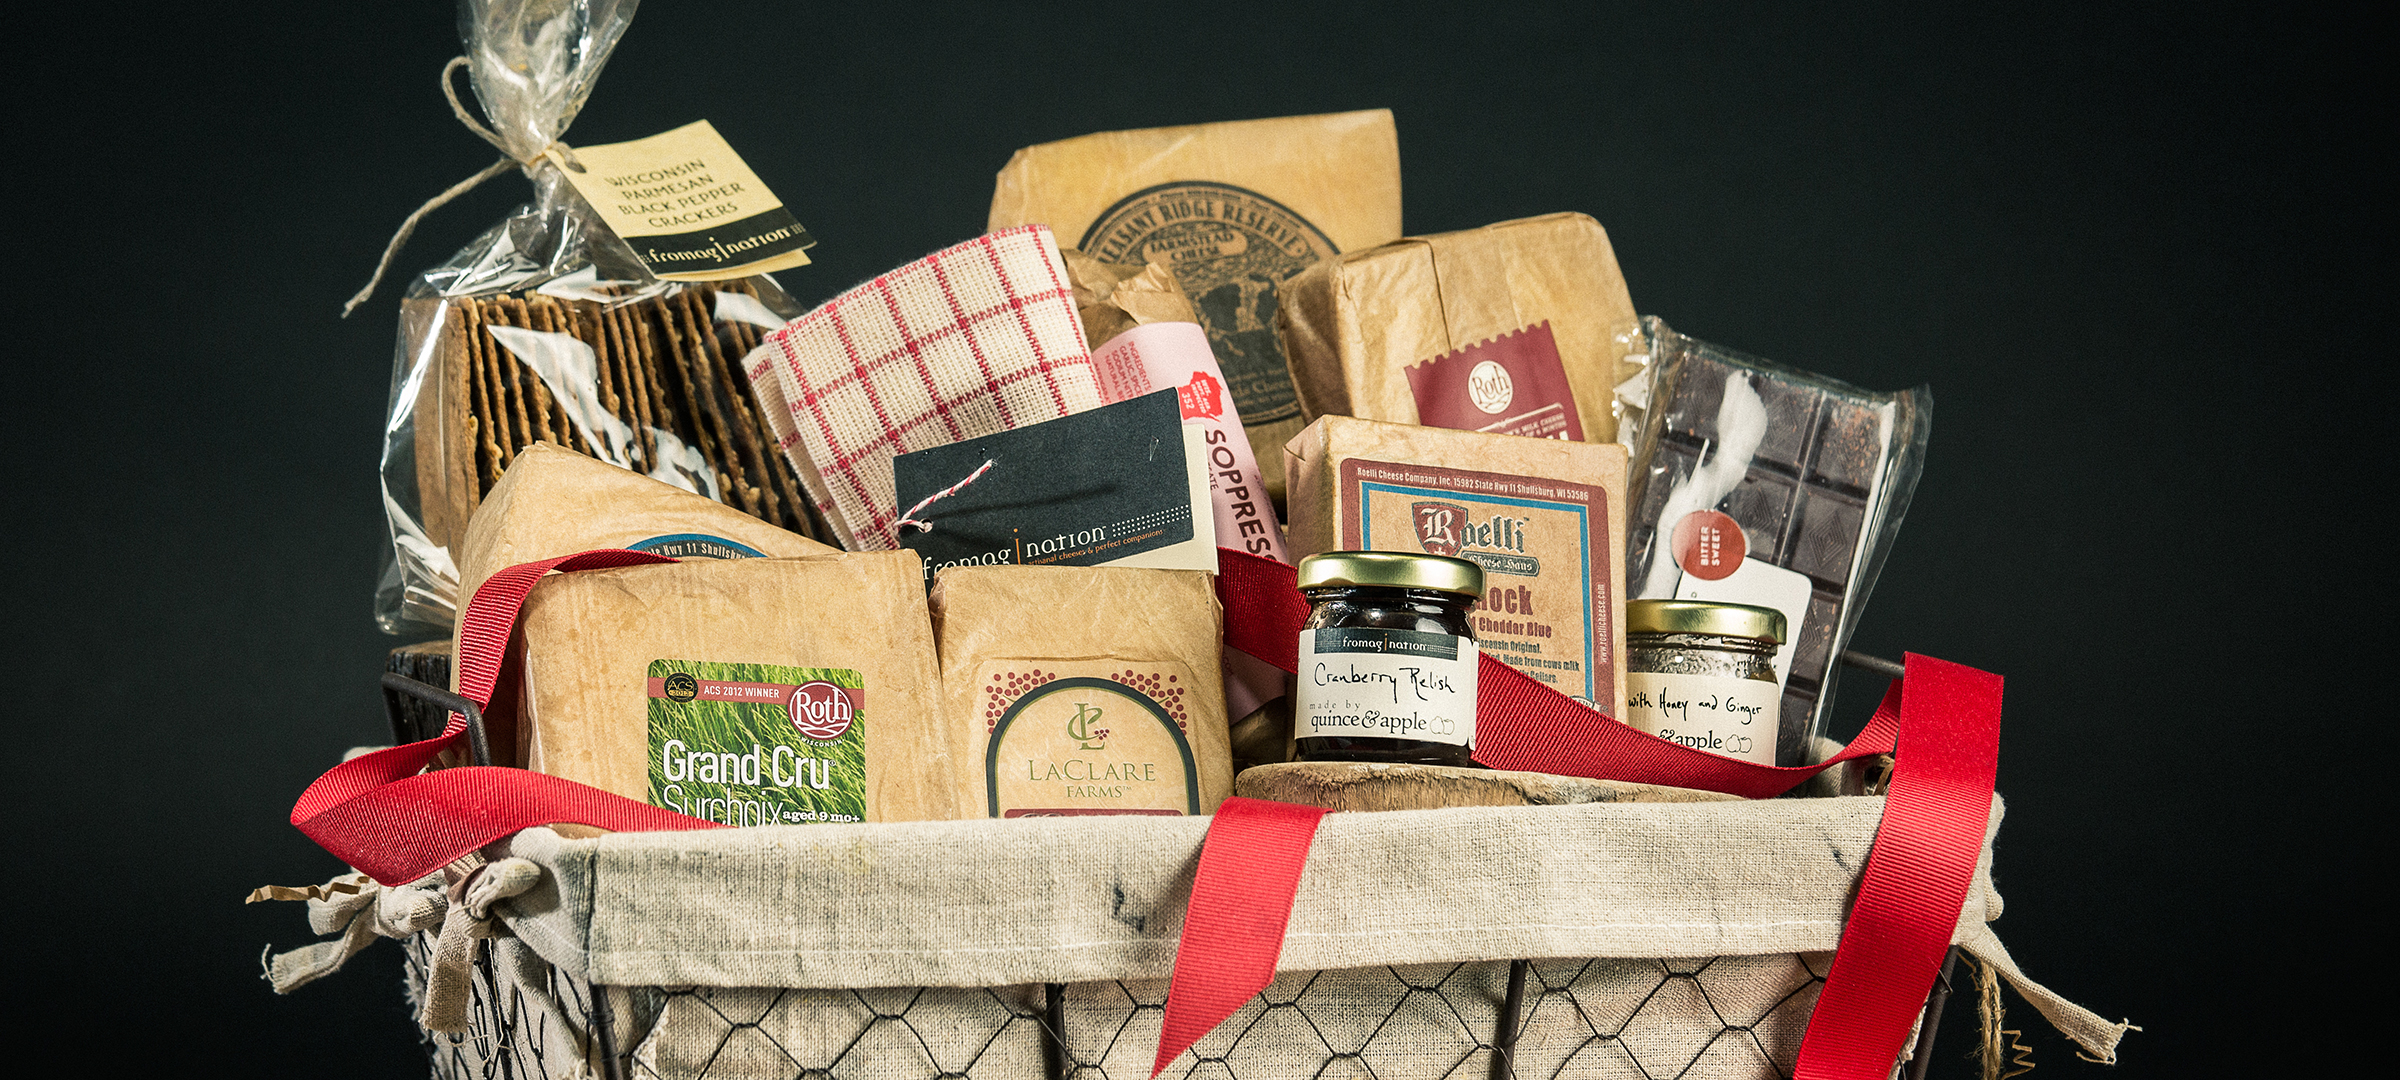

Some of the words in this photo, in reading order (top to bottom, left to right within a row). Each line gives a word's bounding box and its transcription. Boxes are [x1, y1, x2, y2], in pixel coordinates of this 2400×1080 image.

[604, 159, 706, 187] WISCONSIN
[621, 174, 714, 200] PARMESAN
[618, 201, 676, 215] BLACK
[677, 182, 745, 208] PEPPER
[649, 201, 738, 228] CRACKERS
[1159, 201, 1215, 222] RIDGE
[1223, 203, 1298, 249] RESERVE
[1151, 233, 1234, 253] FARMSTEAD
[1472, 365, 1510, 405] Roth
[1181, 392, 1196, 410] 352
[1357, 467, 1378, 478] Roelli
[1378, 469, 1404, 481] Cheese
[1404, 472, 1439, 485] Company,
[1453, 477, 1474, 488] 15982
[1474, 479, 1493, 490] State
[1494, 482, 1508, 492] Hwy
[1509, 483, 1517, 492] 11
[1517, 484, 1555, 498] Shullsburg,
[1556, 488, 1566, 498] WI
[1566, 489, 1589, 500] 53586
[1058, 548, 1086, 561] cheeses
[1087, 546, 1094, 555] &
[1094, 539, 1122, 554] perfect
[1122, 528, 1164, 546] companions
[1421, 507, 1525, 554] Roelli
[662, 544, 683, 557] Hwy
[686, 541, 697, 554] 11
[1700, 526, 1710, 567] BITTER
[1711, 527, 1721, 567] SWEET
[1504, 557, 1534, 572] Haus
[1477, 638, 1509, 650] isconsin
[1526, 622, 1552, 639] Blue
[1524, 656, 1542, 668] from
[1542, 659, 1562, 671] cows
[1562, 660, 1580, 672] milk
[704, 685, 721, 696] ACS
[723, 686, 743, 698] 2012
[744, 687, 780, 699] WINNER
[1314, 662, 1398, 704] Cranberry
[1398, 667, 1455, 701] Relish
[795, 688, 850, 725] Roth
[1309, 699, 1337, 710] made
[1345, 699, 1361, 711] by
[1628, 691, 1653, 708] with
[1659, 687, 1689, 722] Honey
[1698, 694, 1718, 710] and
[1725, 696, 1763, 725] Ginger
[800, 736, 844, 748] WISCONSIN
[663, 739, 760, 787] Grand
[771, 745, 831, 790] Cru
[663, 784, 784, 828] Surchoix
[782, 810, 816, 823] aged
[818, 811, 828, 822] 9
[829, 812, 861, 823] mo+
